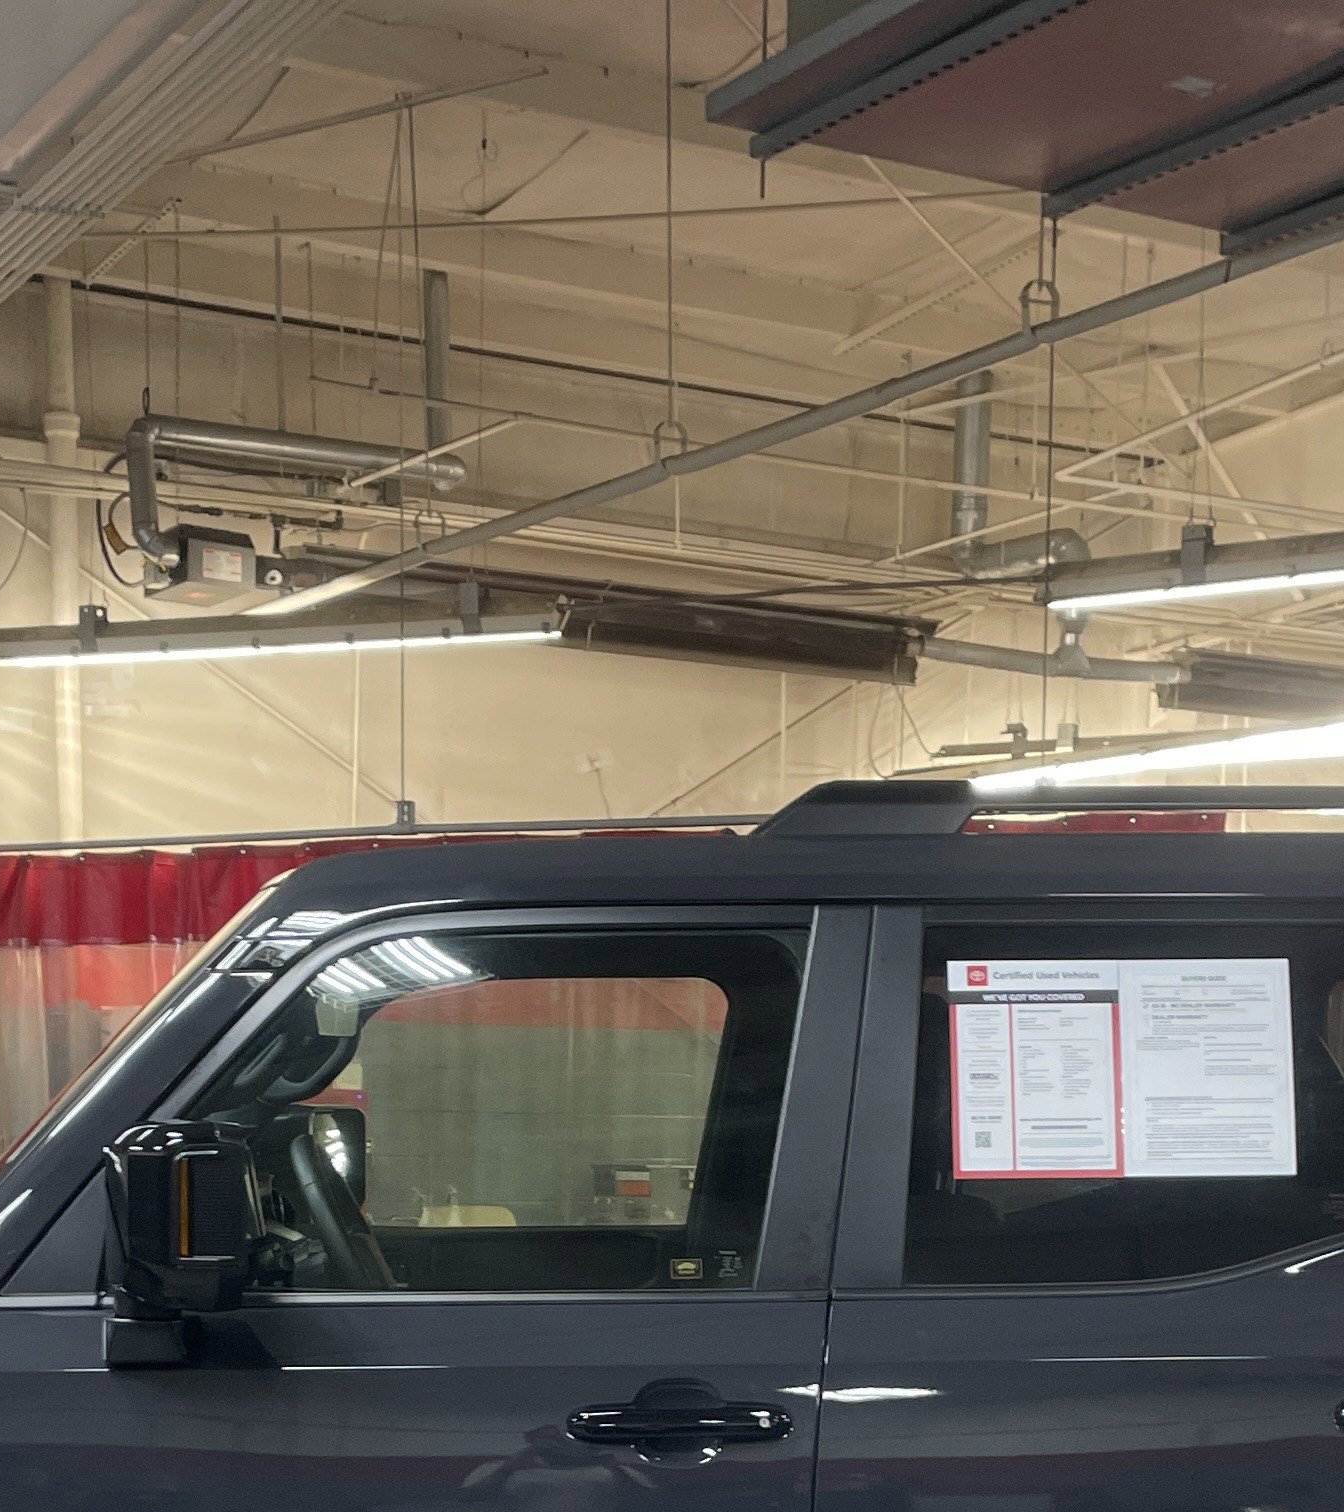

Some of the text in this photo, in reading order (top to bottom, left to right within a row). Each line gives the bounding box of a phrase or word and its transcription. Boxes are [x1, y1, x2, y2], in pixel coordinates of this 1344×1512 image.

[992, 971, 1100, 980] Certified Used Vehicles
